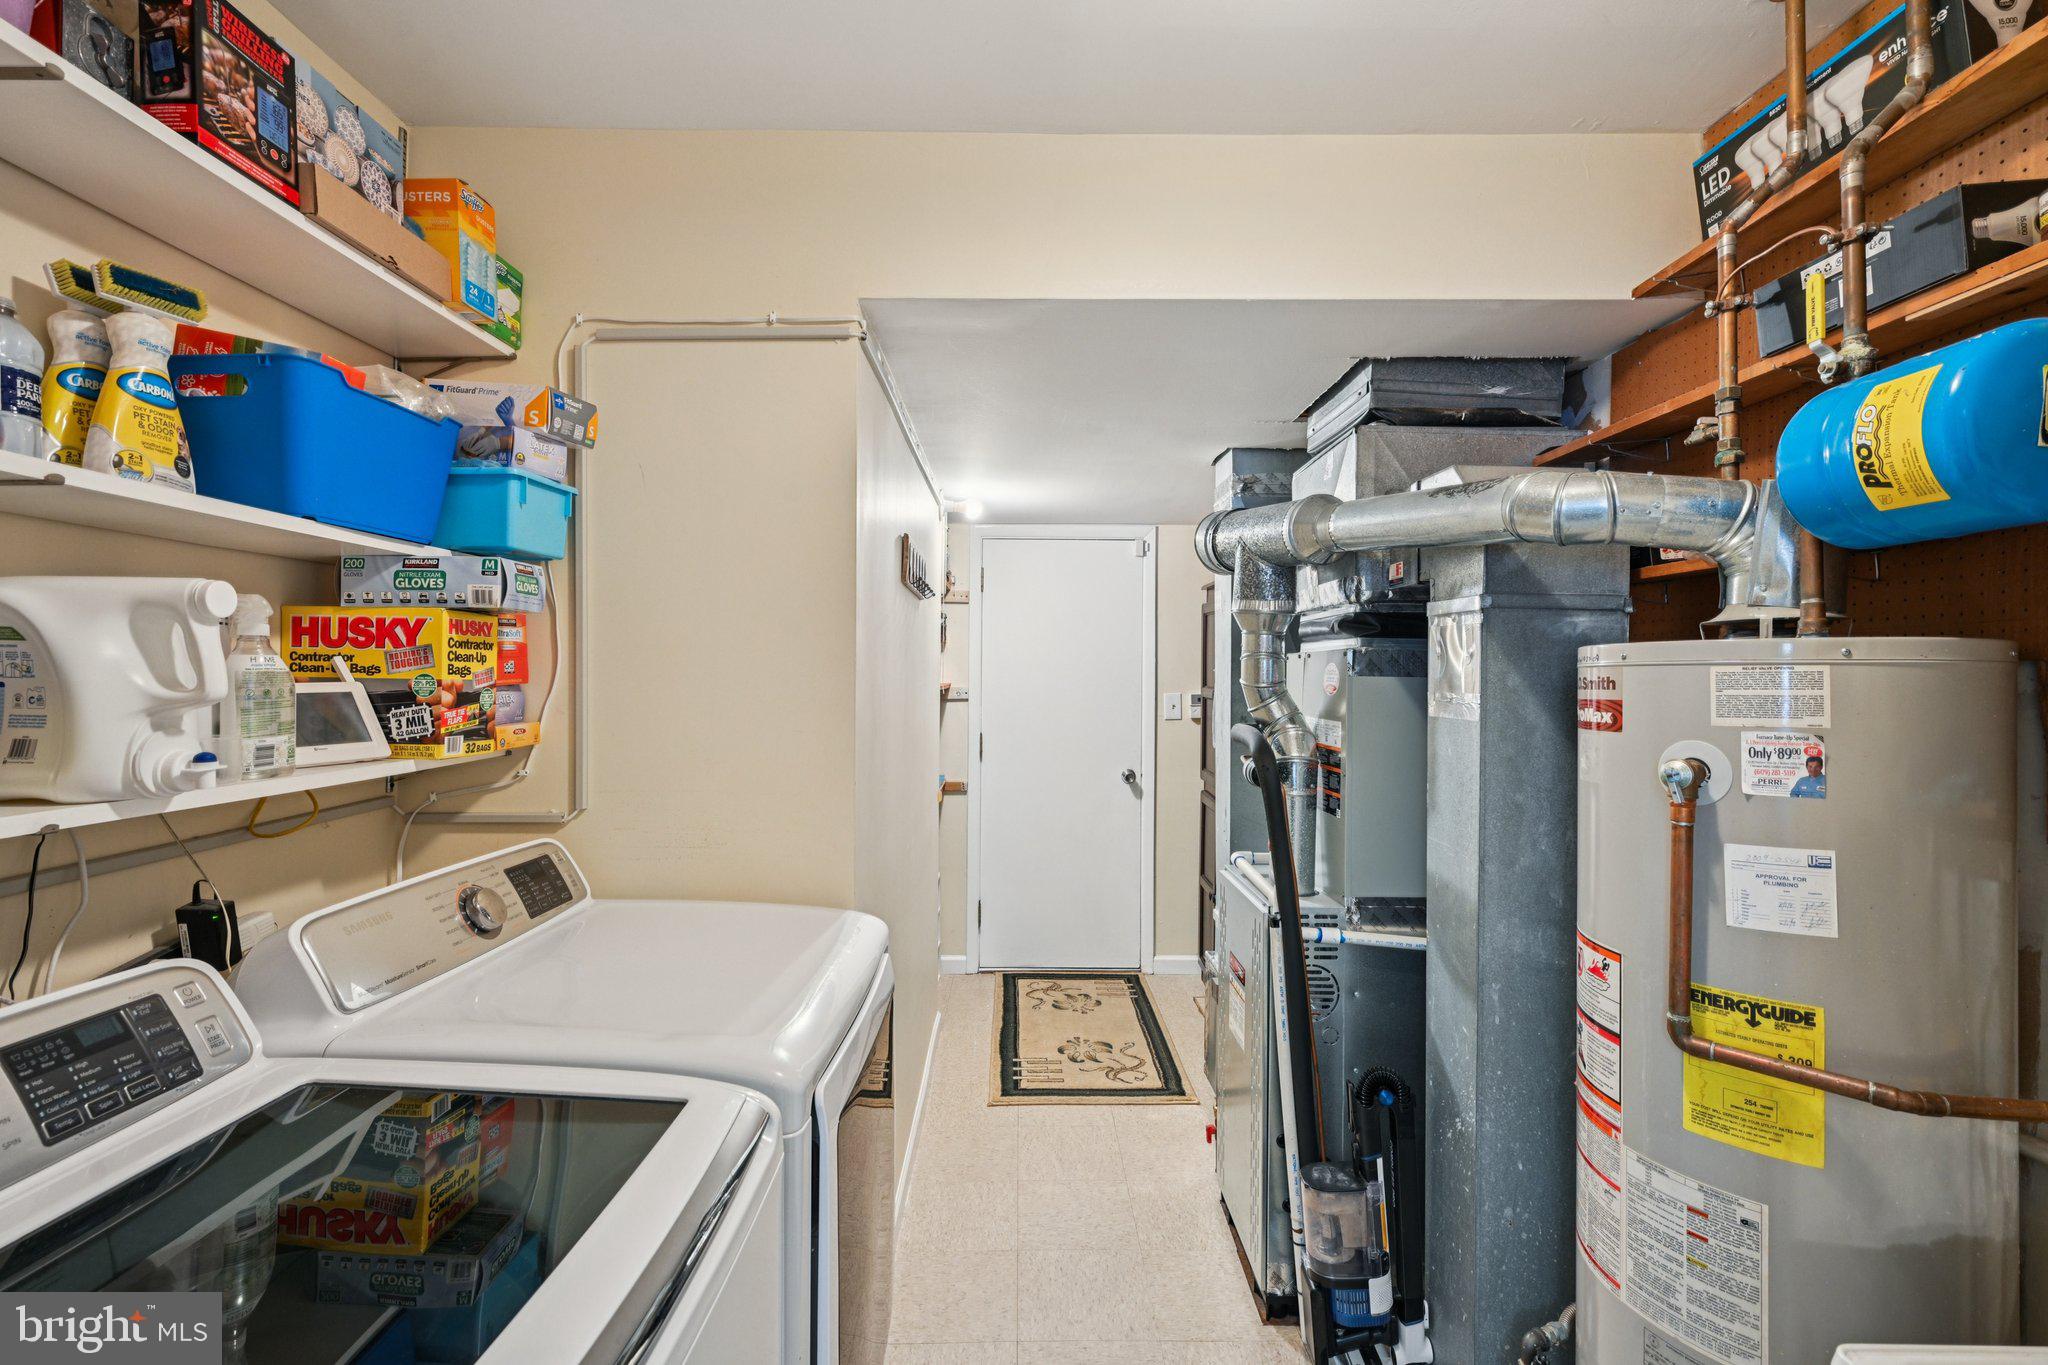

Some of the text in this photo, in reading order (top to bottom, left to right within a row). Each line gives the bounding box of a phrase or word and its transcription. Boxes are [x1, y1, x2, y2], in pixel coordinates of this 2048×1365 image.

[220, 4, 285, 63] WIRELESS
[221, 17, 285, 75] GRILLING
[1701, 166, 1731, 201] LED
[402, 191, 452, 202] USTERS
[1703, 184, 1732, 208] Dimmable
[1706, 210, 1723, 225] FLOOD
[469, 285, 479, 297] 24
[446, 385, 500, 396] FitGuard Prime
[73, 407, 90, 417] PET
[133, 405, 176, 421] OXY POWERED
[528, 410, 540, 425] S
[133, 411, 177, 429] PET STAIN
[142, 430, 172, 443] REMOVER
[148, 423, 175, 438] ODOR
[588, 426, 595, 438] S
[1855, 404, 1895, 489] PROFLO
[1883, 387, 1908, 497] Thermal Expansion Tank
[345, 559, 364, 569] 200
[485, 560, 495, 570] M
[395, 578, 445, 589] GLOVES
[516, 581, 539, 594] GLOVES
[290, 615, 429, 650] HUSKY
[449, 618, 494, 637] HUSKY
[447, 637, 494, 650] Contractor
[447, 650, 487, 665] Clean-Up
[350, 663, 382, 676] Bags
[447, 664, 472, 678] Bags
[392, 707, 427, 719] HEAVY DUTY
[395, 718, 403, 731] 3
[405, 715, 428, 729] MIL
[447, 716, 463, 725] FLAPS
[405, 727, 430, 736] GALLON
[465, 742, 492, 753] 32 BAGS
[1748, 746, 1772, 761] Only
[1757, 778, 1783, 786] PERRI
[1755, 873, 1790, 881] APPROVAL
[1763, 880, 1799, 888] PLUMBING
[342, 911, 394, 937] SAMSUNG
[183, 994, 202, 1005] POWER
[1690, 987, 1817, 1028] ENERGYGUIDE
[207, 1033, 223, 1043] START
[1737, 1033, 1752, 1041] YEARLY
[1752, 1037, 1775, 1047] OPERATING
[119, 1053, 135, 1061] Heavy
[75, 1061, 89, 1070] High
[123, 1059, 143, 1070] Normal
[80, 1066, 102, 1078] Medium
[129, 1070, 142, 1079] Light
[32, 1078, 44, 1087] Hot
[84, 1079, 97, 1087] Low
[97, 1083, 111, 1094] Spin
[130, 1079, 157, 1096] Soil Level
[37, 1084, 56, 1096] Warm
[42, 1089, 71, 1105] Eco Warm
[1744, 1098, 1757, 1107] 254
[99, 1099, 114, 1110] Spin
[1723, 1111, 1739, 1120] DEPEND
[1761, 1121, 1778, 1130] UTILITY
[1778, 1126, 1794, 1134] RATES
